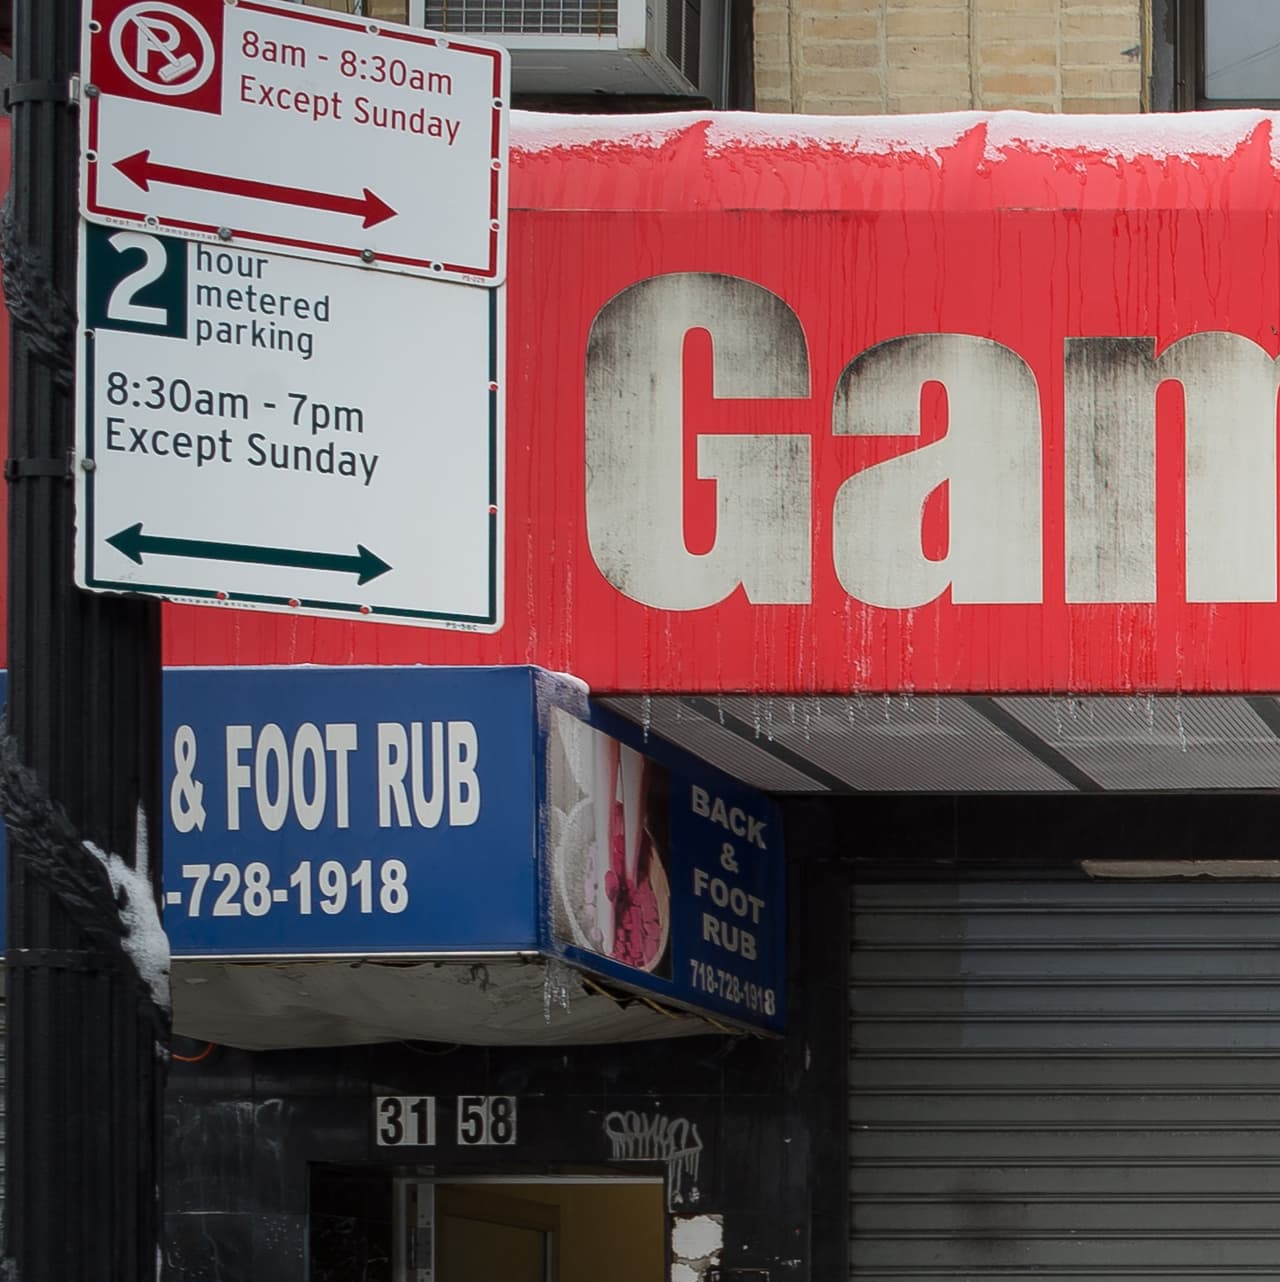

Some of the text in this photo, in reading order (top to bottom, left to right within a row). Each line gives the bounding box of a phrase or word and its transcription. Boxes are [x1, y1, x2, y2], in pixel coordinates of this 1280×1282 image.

[241, 30, 306, 69] 8am
[339, 49, 453, 96] 8:30am
[240, 75, 461, 146] Except Sunday
[107, 231, 168, 326] 2
[196, 243, 269, 279] hour
[196, 284, 330, 323] metered
[196, 318, 314, 360] parking
[106, 371, 249, 420] 8:30am
[287, 392, 364, 435] 7pm
[105, 416, 379, 487] Except Sunday
[169, 720, 481, 833] & FOOT RUB
[690, 783, 768, 851] BACK
[161, 859, 410, 917] -728-1918
[719, 842, 740, 875] &
[692, 866, 766, 925] FOOT
[702, 912, 758, 962] RUB
[688, 958, 776, 1017] 718-728-1918
[379, 1096, 514, 1145] 31 58
